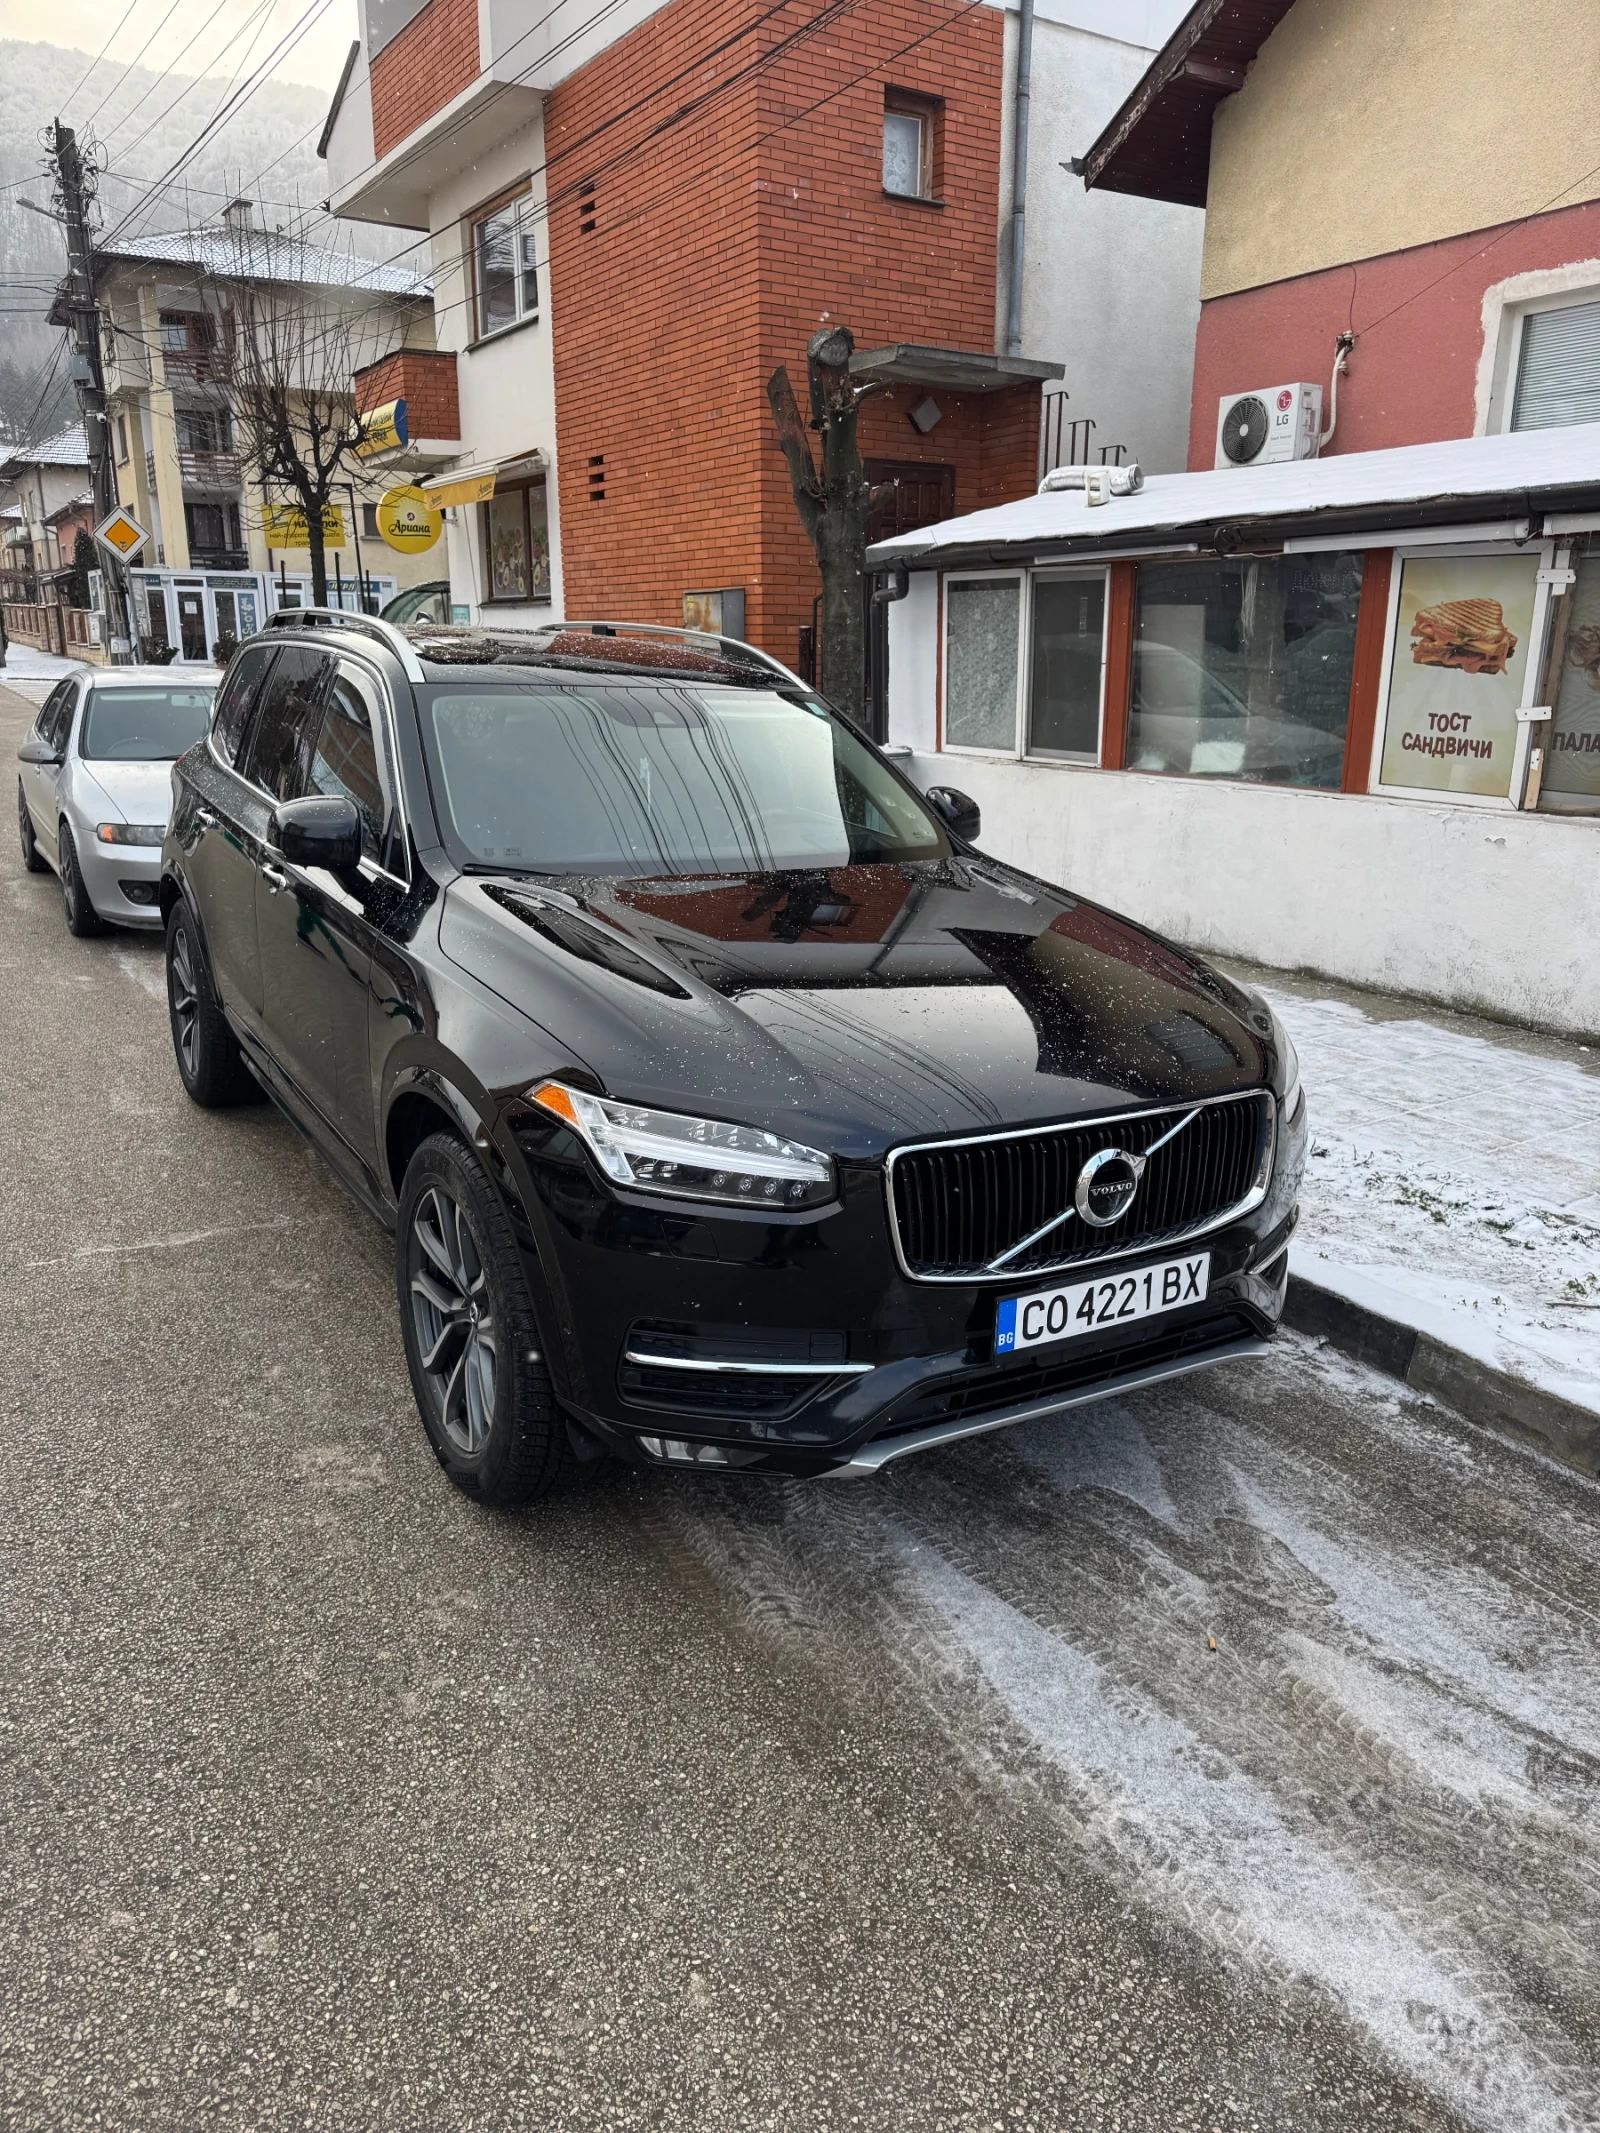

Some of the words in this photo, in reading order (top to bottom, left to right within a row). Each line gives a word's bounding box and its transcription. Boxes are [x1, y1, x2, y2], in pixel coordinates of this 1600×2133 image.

[1276, 414, 1289, 426] LG
[388, 519, 431, 537] Ариана
[1428, 712, 1472, 733] ТОСТ
[1401, 732, 1493, 759] САНДВИЧИ
[1090, 1182, 1133, 1197] VOLVO
[1075, 1272, 1153, 1327] 4221
[998, 1332, 1014, 1347] BG
